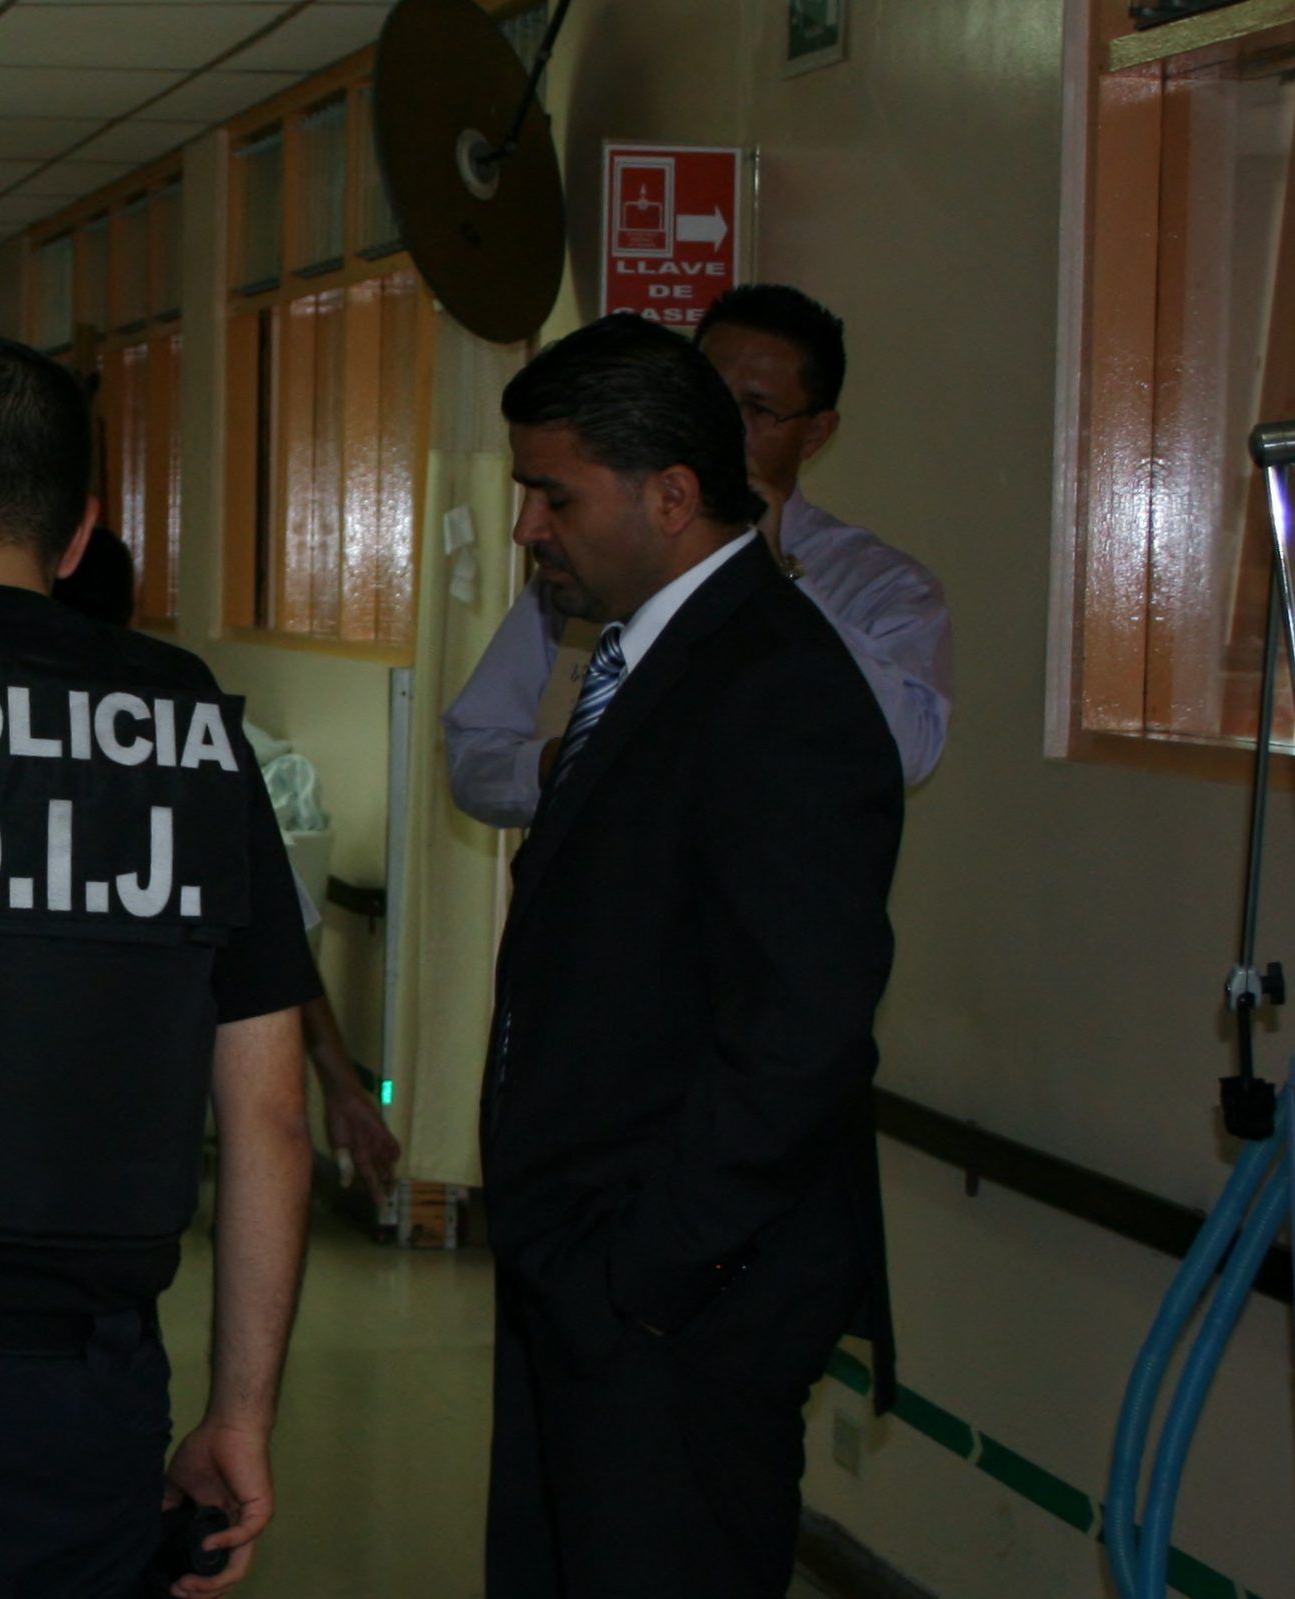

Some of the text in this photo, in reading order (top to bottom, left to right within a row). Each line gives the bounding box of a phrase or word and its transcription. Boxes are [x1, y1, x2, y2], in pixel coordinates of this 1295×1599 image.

[616, 261, 726, 276] LLAVE
[648, 284, 694, 298] DE
[612, 307, 706, 321] ASE
